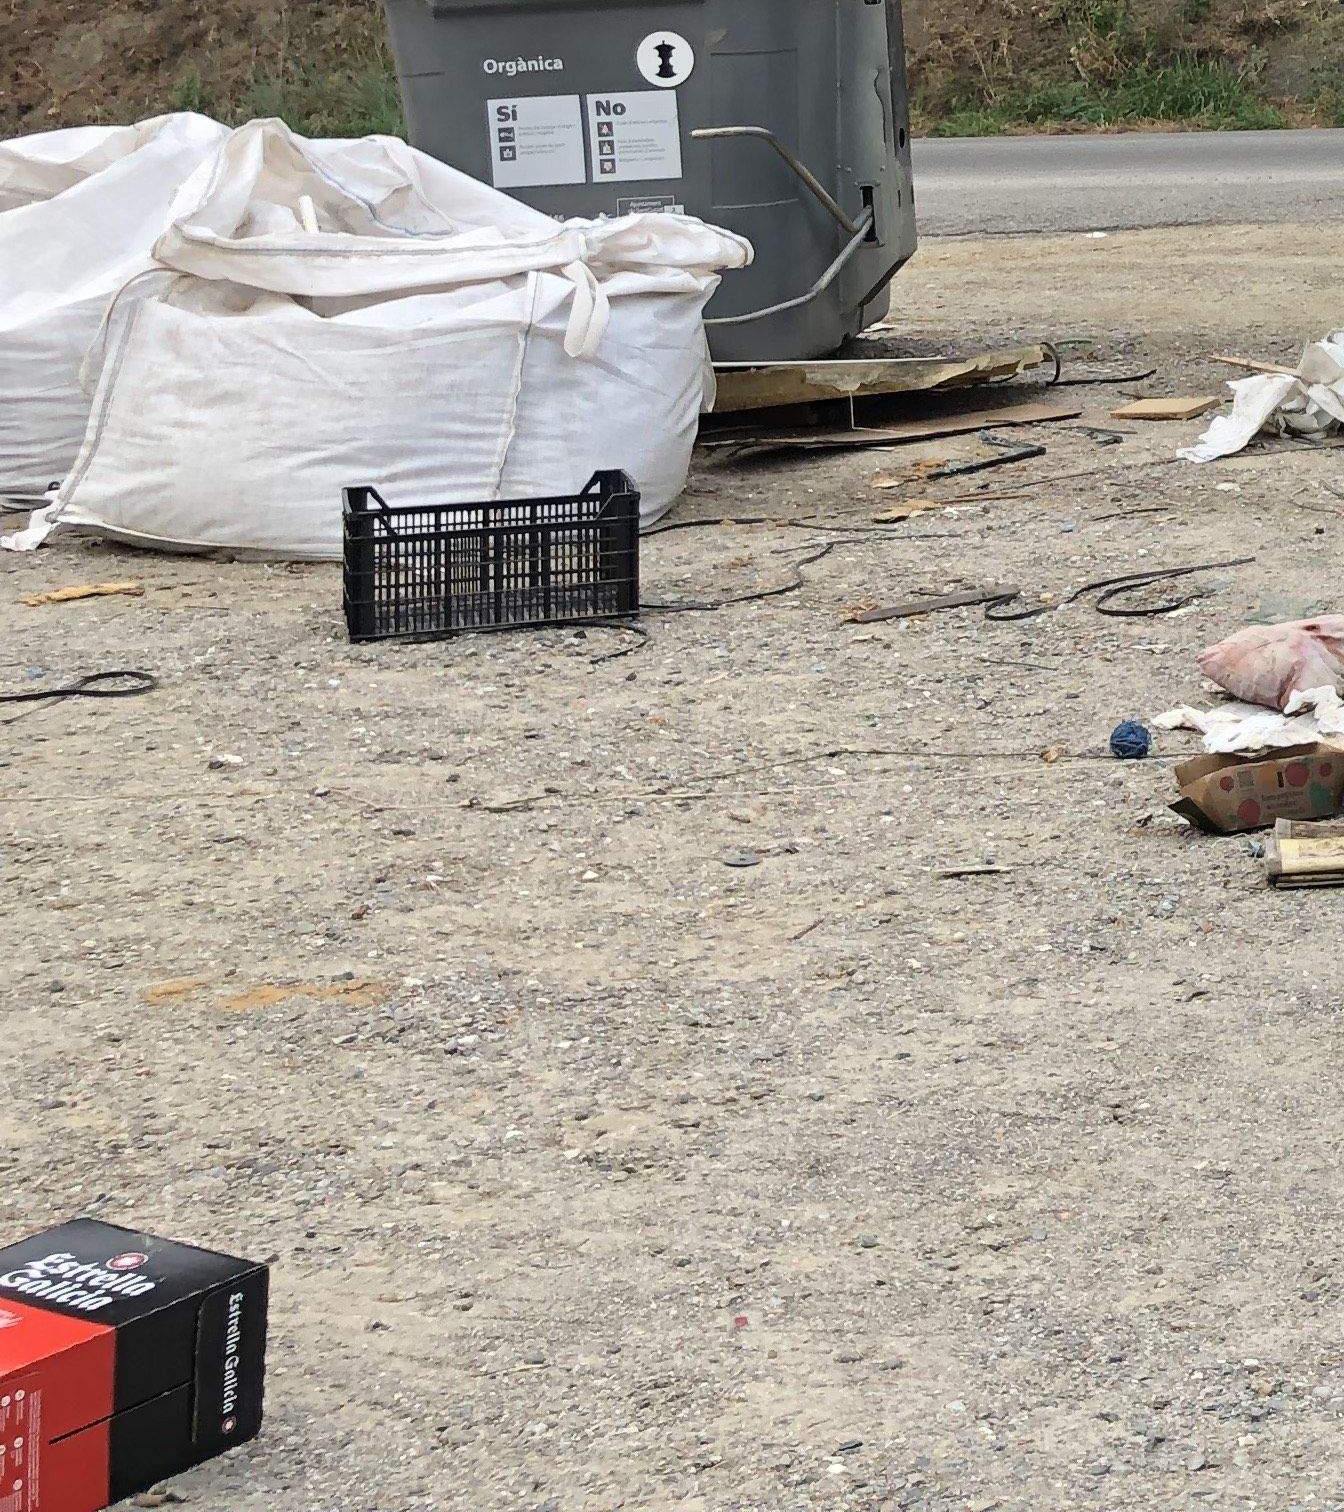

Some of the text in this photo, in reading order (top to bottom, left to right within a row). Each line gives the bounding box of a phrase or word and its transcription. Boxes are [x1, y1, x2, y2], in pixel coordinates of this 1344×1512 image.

[483, 56, 564, 77] Orgànica
[496, 104, 518, 123] Sí
[595, 99, 627, 117] No
[1, 1267, 113, 1311] Galicia
[25, 1252, 156, 1297] Estrella
[222, 1291, 247, 1414] Estrella Galicia
